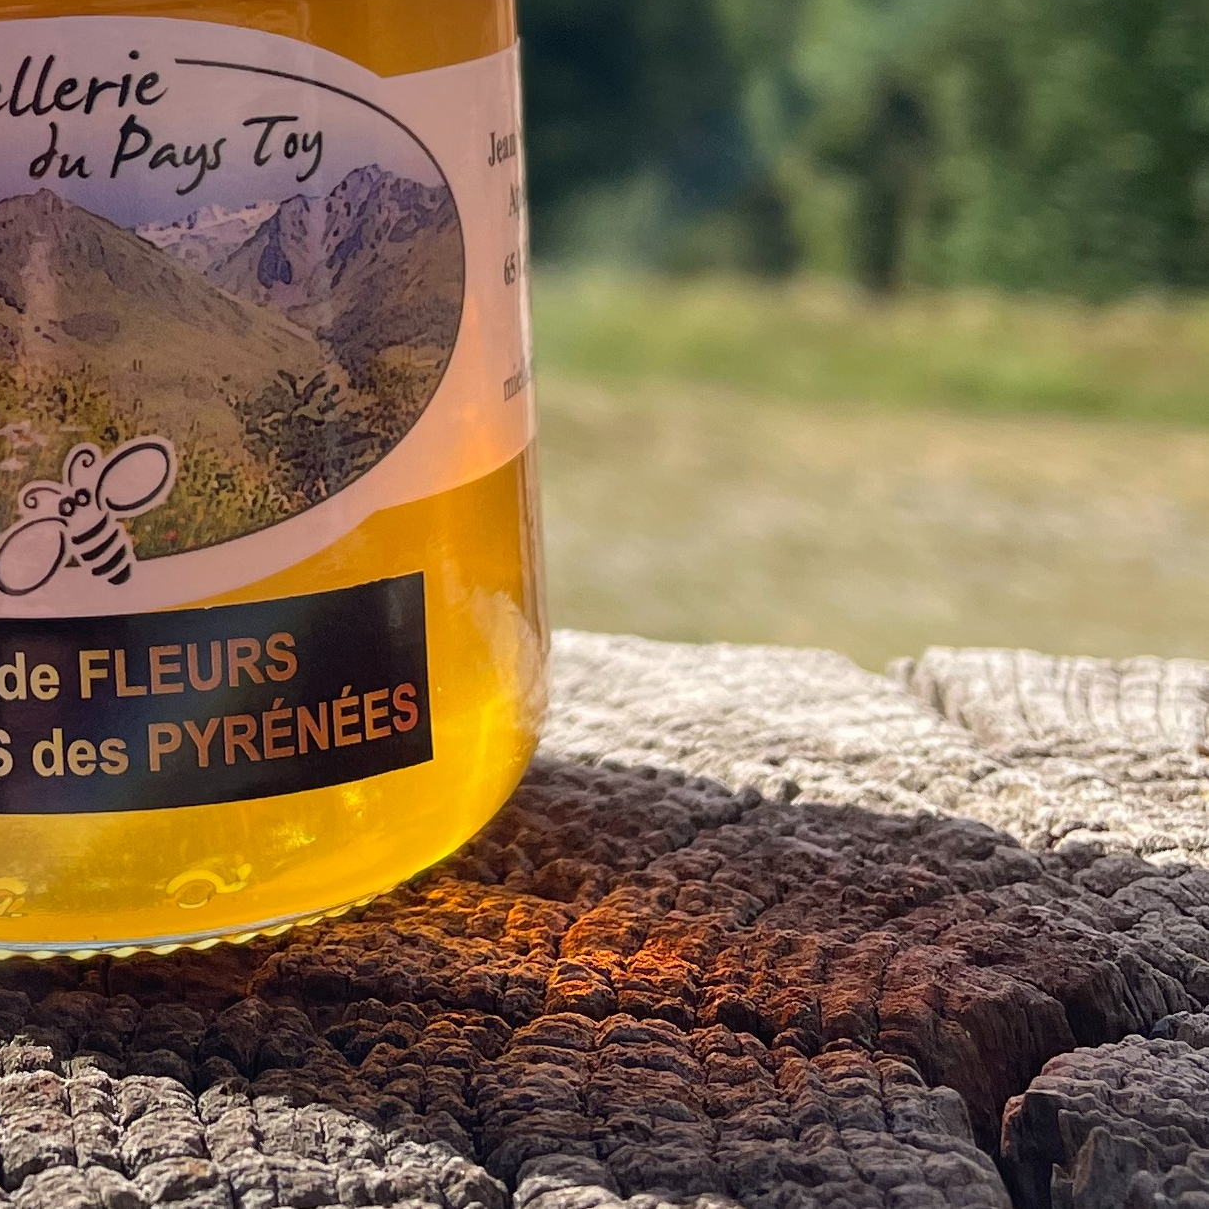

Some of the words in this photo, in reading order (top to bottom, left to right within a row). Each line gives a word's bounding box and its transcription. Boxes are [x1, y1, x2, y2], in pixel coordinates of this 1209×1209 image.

[29, 121, 92, 179] du
[110, 114, 227, 196] Pays
[243, 115, 323, 182] Toy
[488, 131, 516, 168] Jean
[78, 631, 298, 699] FLEURS
[31, 727, 130, 778] des
[148, 682, 420, 772] PYRÉNÉES
